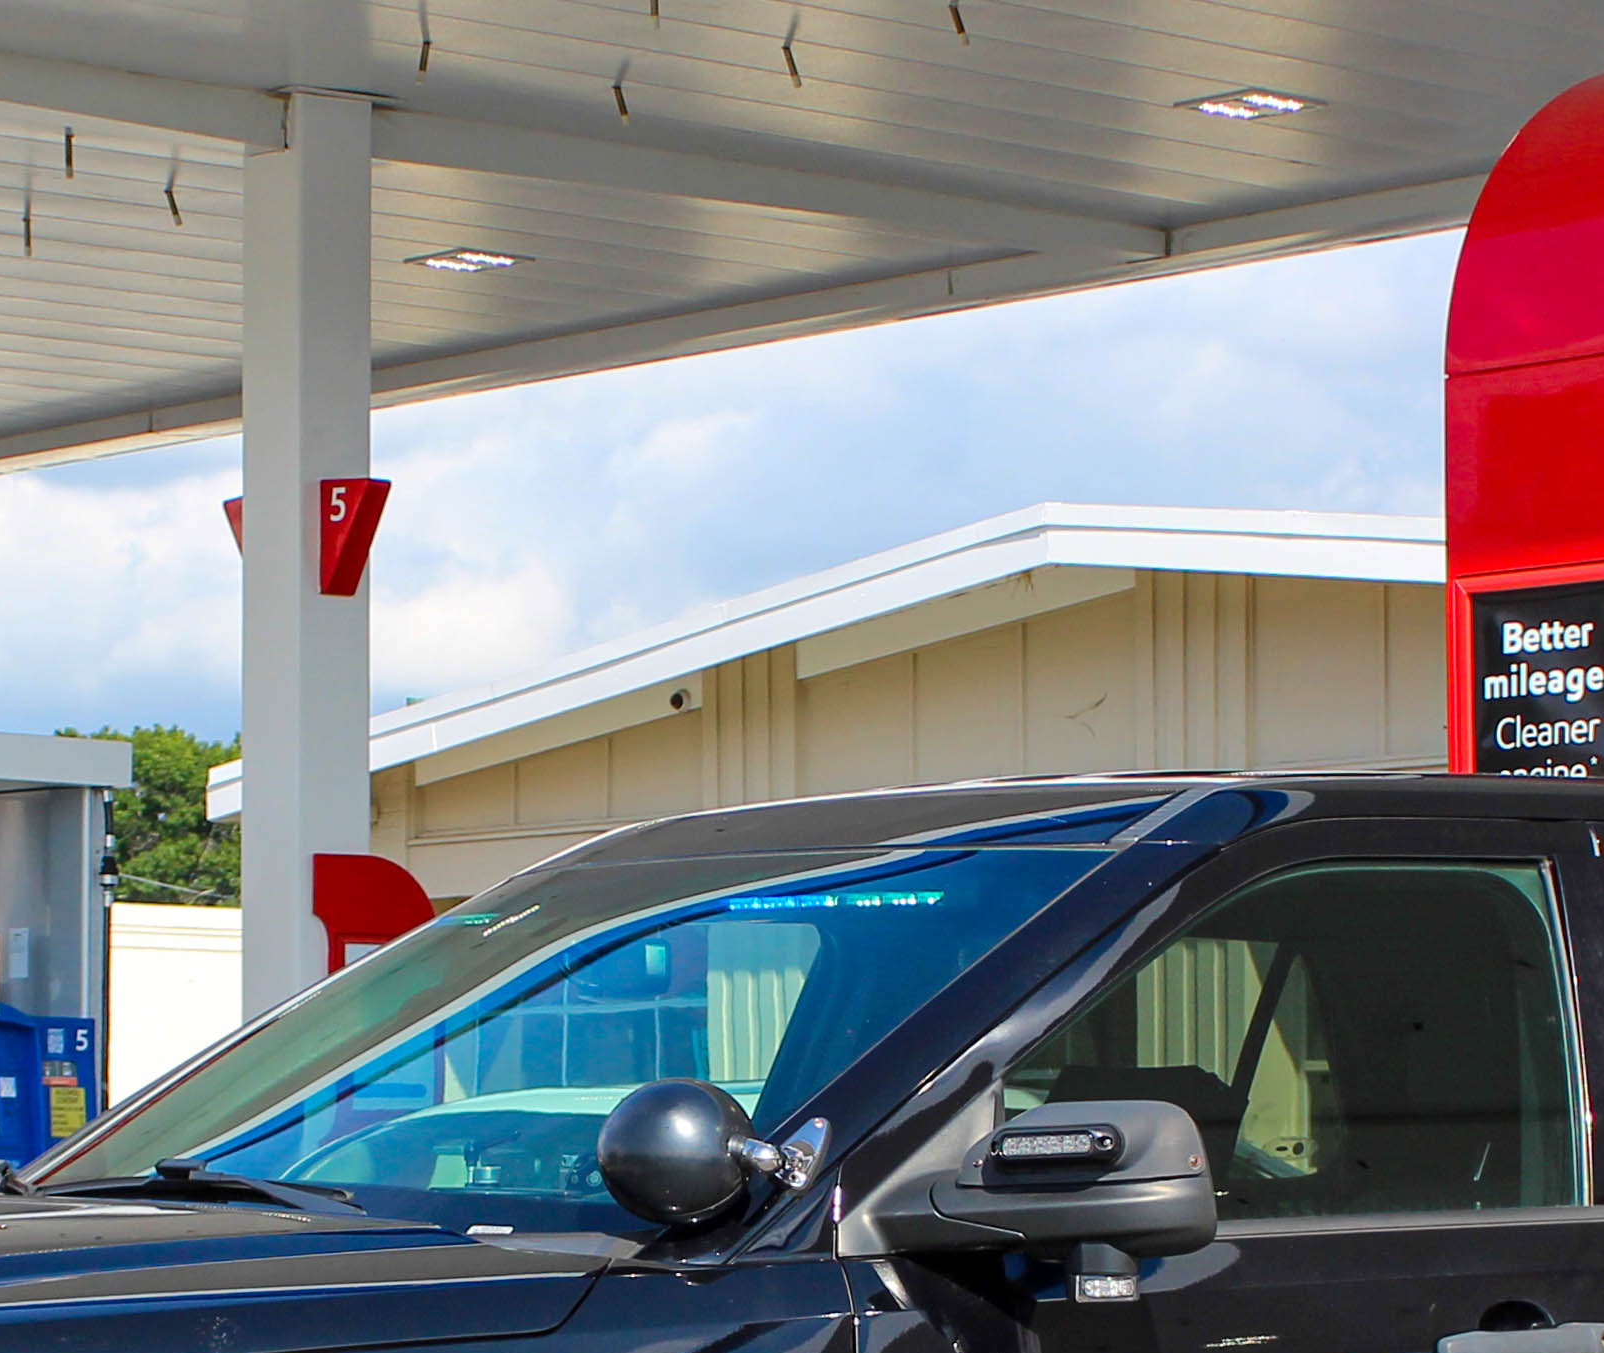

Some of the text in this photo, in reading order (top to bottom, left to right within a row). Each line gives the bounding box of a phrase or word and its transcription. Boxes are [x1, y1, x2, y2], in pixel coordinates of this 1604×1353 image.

[329, 487, 347, 522] 5
[1502, 620, 1594, 654] Better
[1496, 715, 1601, 750] Cleaner
[75, 1028, 89, 1052] 5
